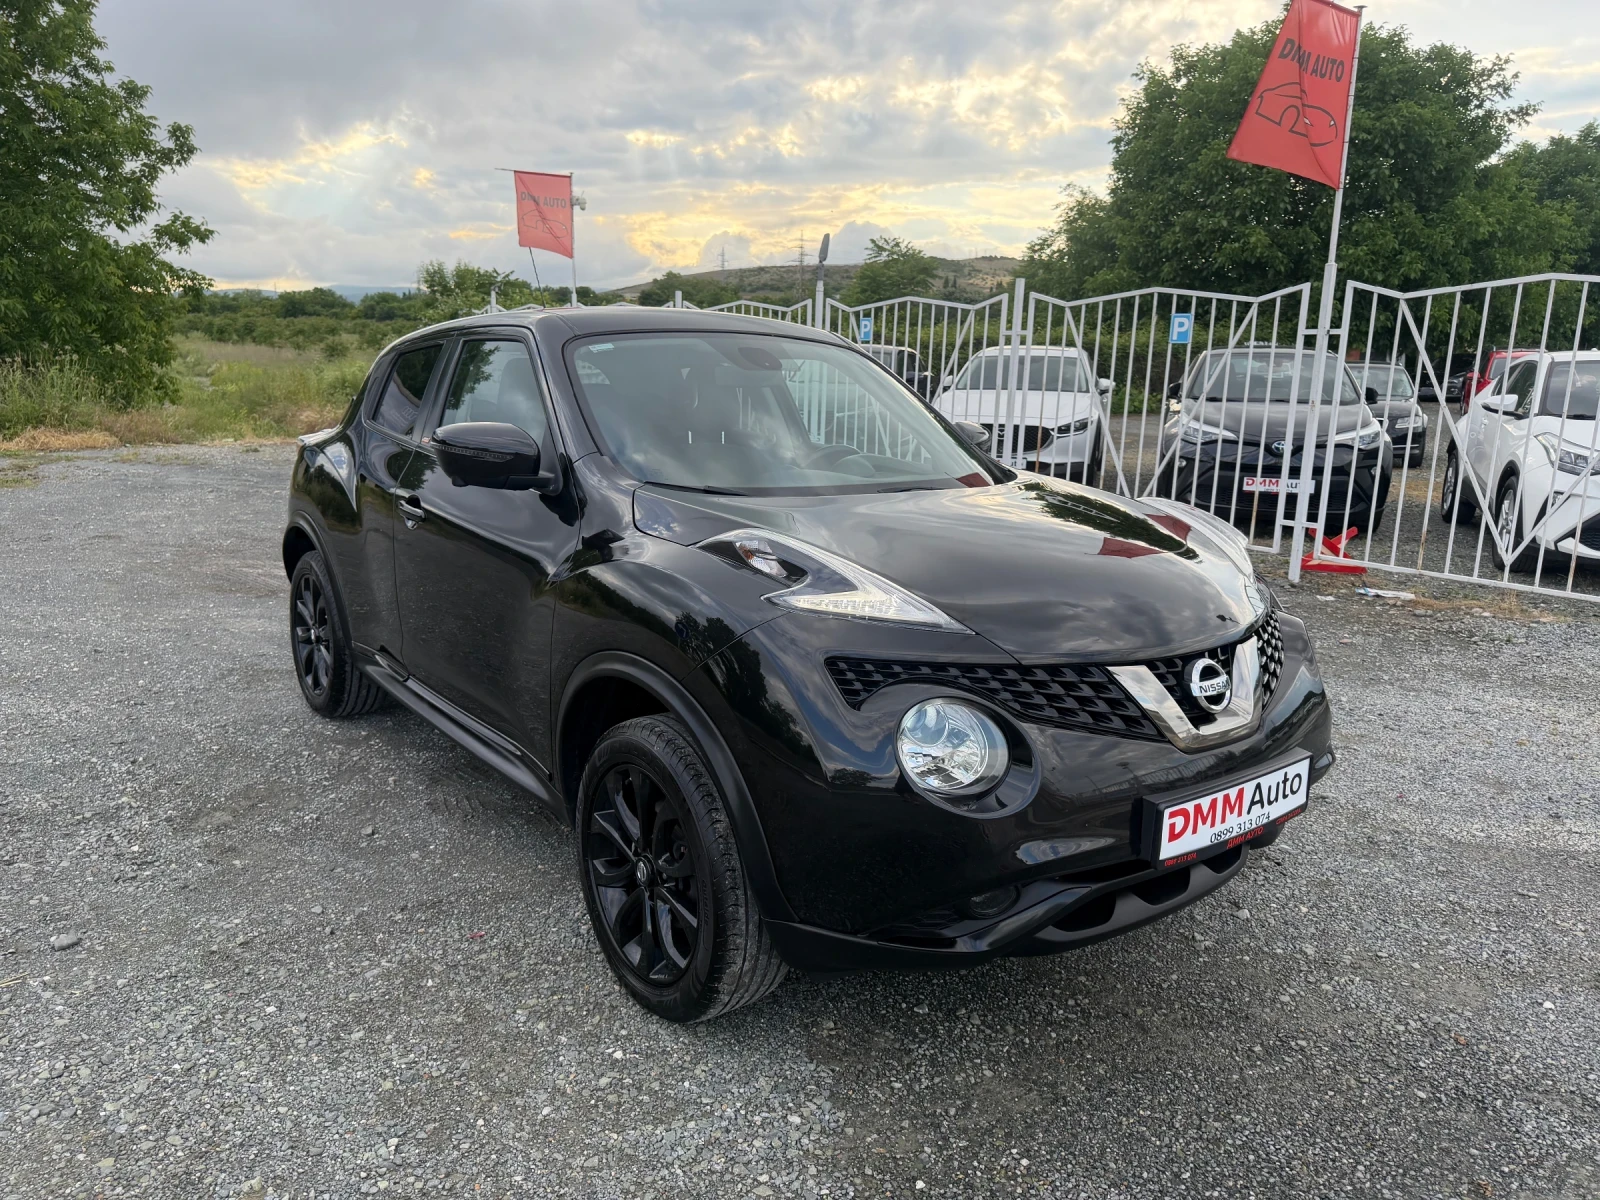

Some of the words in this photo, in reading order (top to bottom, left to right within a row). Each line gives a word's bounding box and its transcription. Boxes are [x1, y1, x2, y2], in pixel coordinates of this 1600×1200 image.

[1310, 54, 1344, 82] AUTO
[543, 197, 566, 208] AUTO
[861, 320, 871, 338] P
[1172, 317, 1189, 340] P
[1199, 677, 1230, 694] NISSAN
[1167, 786, 1244, 843] DMM
[1247, 771, 1302, 815] Auto
[1210, 826, 1234, 843] 0899
[1236, 818, 1253, 834] 313
[1255, 811, 1270, 826] 074
